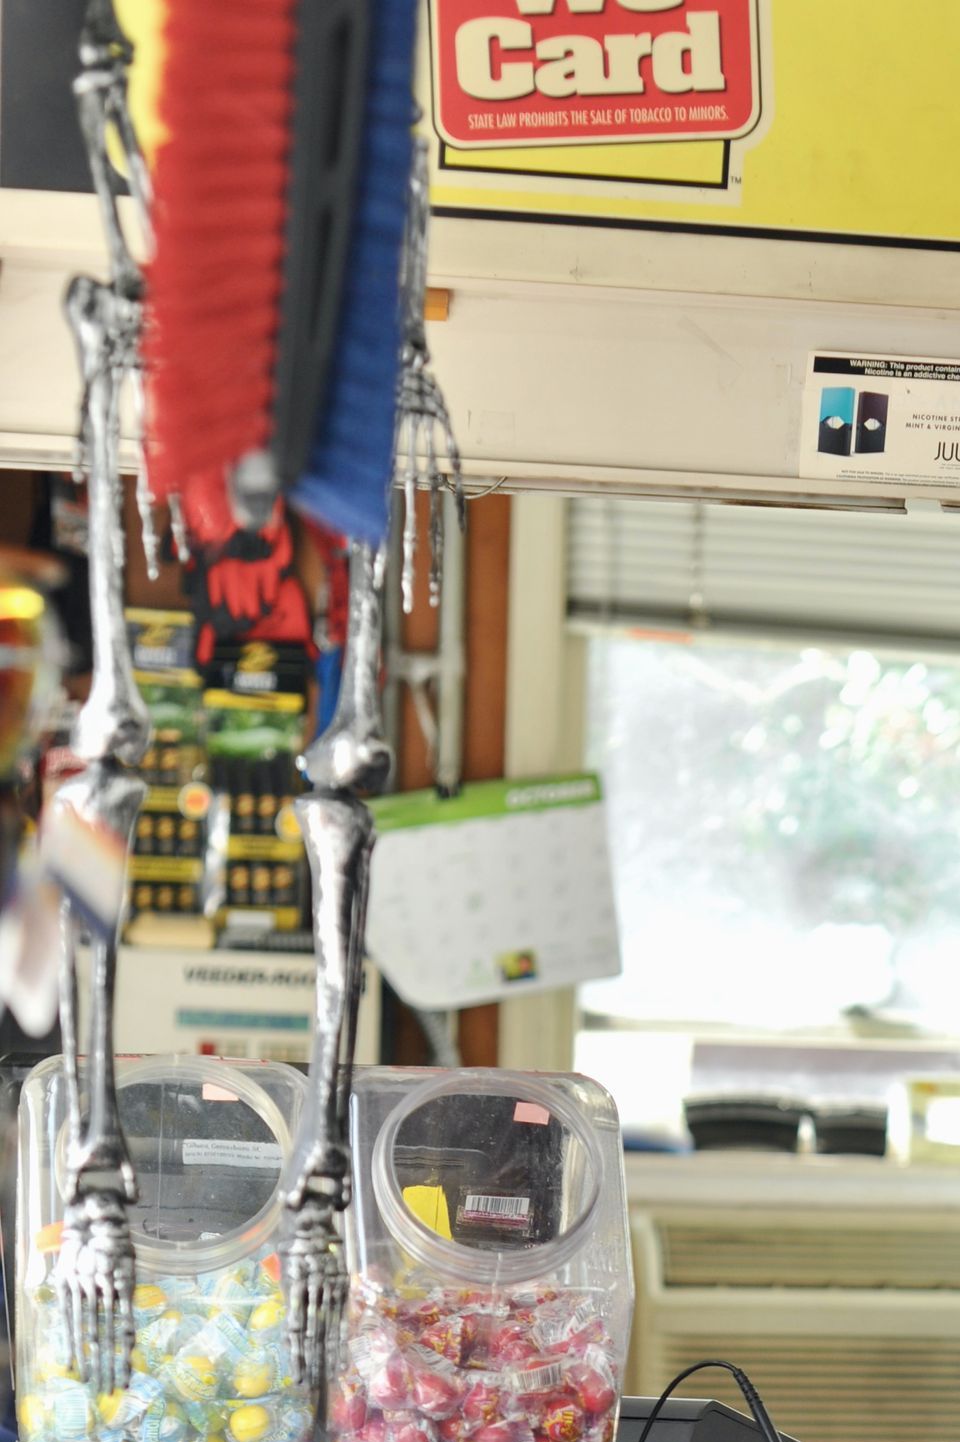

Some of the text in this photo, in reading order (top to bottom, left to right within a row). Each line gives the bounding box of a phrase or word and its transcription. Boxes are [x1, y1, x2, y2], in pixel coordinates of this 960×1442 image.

[455, 11, 725, 100] Card
[468, 105, 729, 129] STATE LAW PROHIBITS THE SALE OF TOBACCO TO MINORS.
[850, 360, 888, 369] WARNING:
[889, 362, 905, 370] This
[906, 363, 934, 373] product
[865, 368, 894, 376] Nicotine
[895, 369, 901, 377] is
[914, 371, 945, 380] addictive
[912, 413, 947, 422] NICOTINE
[905, 422, 922, 430] MINT
